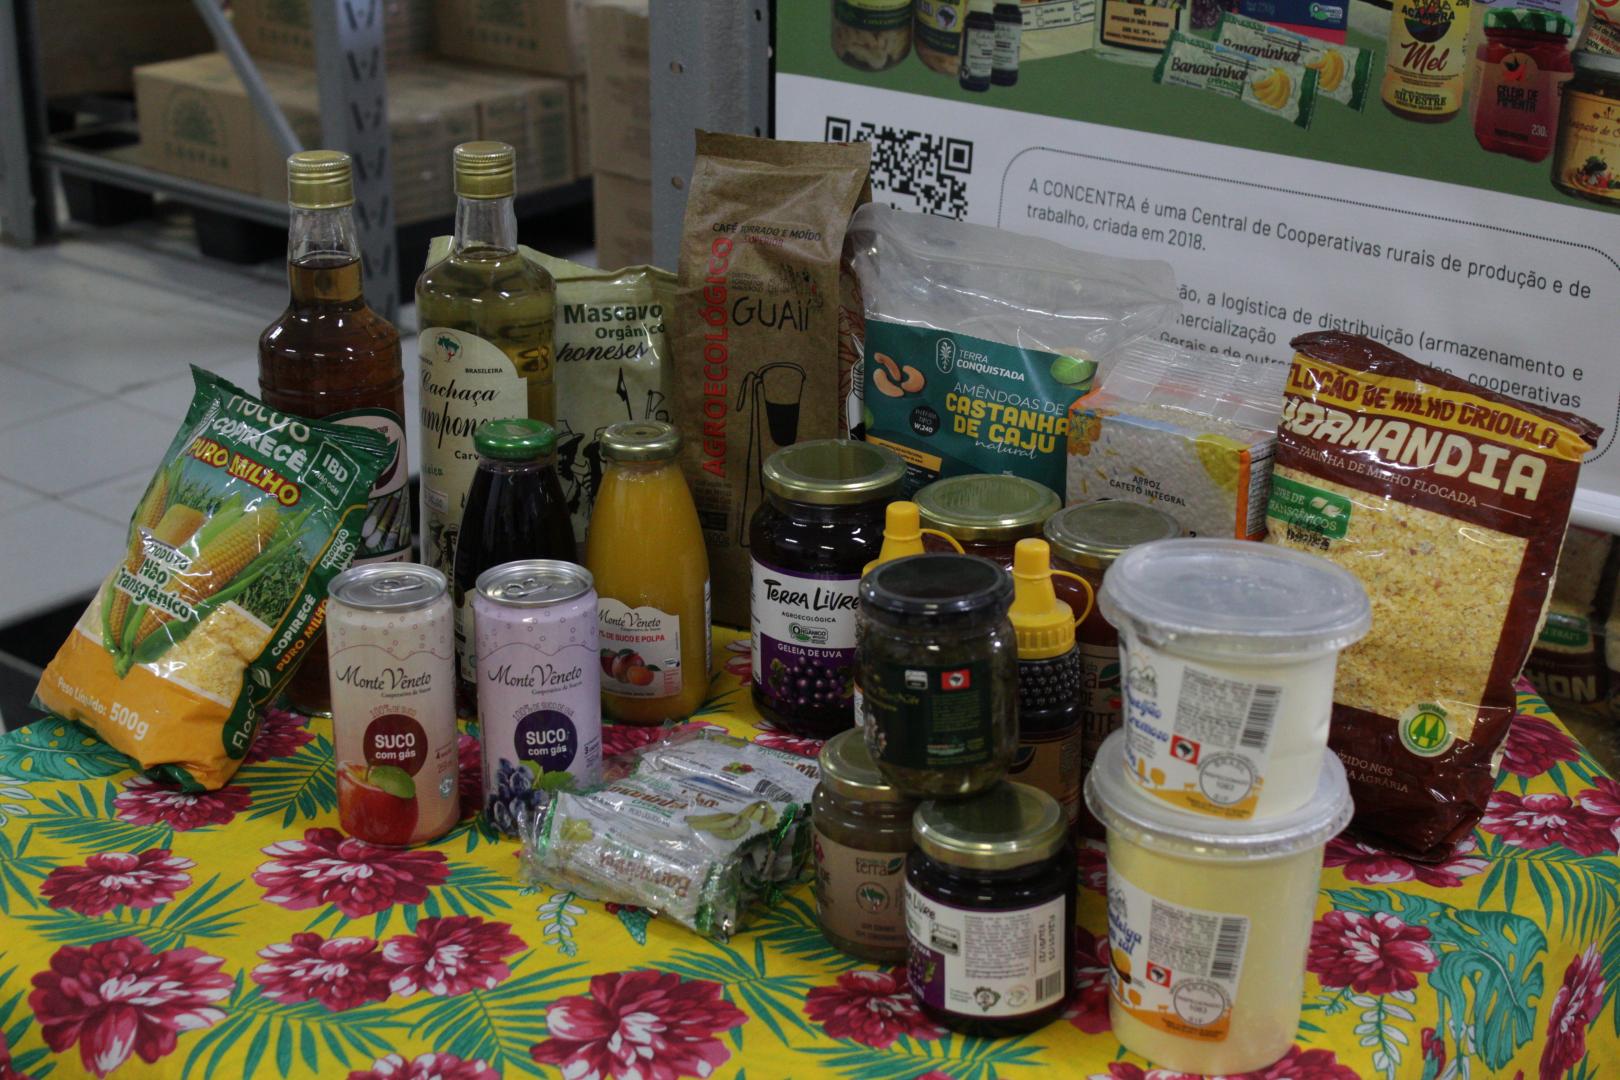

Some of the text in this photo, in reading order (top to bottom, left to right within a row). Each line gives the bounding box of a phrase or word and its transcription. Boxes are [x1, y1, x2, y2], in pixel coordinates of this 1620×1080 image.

[1171, 56, 1249, 81] Bananinha
[1401, 41, 1450, 74] Mel
[712, 221, 739, 234] CAFÉ
[789, 229, 822, 242] MOÍDO
[1026, 204, 1206, 252] trabalho, criada em 2018.
[1029, 178, 1591, 299] A CONCENTRA é uma Central de Cooperativas rurais de produção e de
[563, 302, 664, 325] Mascavo
[595, 322, 666, 342] Orgânico
[1207, 293, 1216, 306] a
[1221, 291, 1287, 321] logística
[1292, 307, 1312, 325] de
[1318, 312, 1414, 347] distribuição
[1419, 330, 1566, 380] (armazenamento
[1571, 369, 1584, 381] e
[464, 367, 504, 375] BRASILEIRA
[699, 237, 734, 478] AGROECOLÓGICO
[957, 359, 1025, 382] CONQUISTADA
[959, 349, 989, 365] TERRA
[421, 368, 500, 408] Cachaça
[952, 381, 1065, 416] AMÊNDOAS DE
[1468, 371, 1581, 409] cooperativas
[944, 391, 1071, 437] CASTANHA
[1287, 362, 1559, 450] LOCÃO DE MILHO CRIOULO
[211, 415, 309, 475] COPIRECÊ
[953, 414, 1057, 455] DE CAJU
[975, 438, 1038, 460] natural
[187, 435, 302, 508] PURO MILHO
[320, 452, 350, 484] IBD
[1297, 444, 1479, 509] FARINHA DE MILHO FLOCADA
[1109, 479, 1187, 507] CATETO INTEGRAL
[1132, 475, 1161, 490] ARROZ
[1290, 492, 1306, 506] DE
[320, 528, 350, 569] PRODUTO
[332, 543, 355, 571] Não
[138, 557, 168, 585] Não
[271, 593, 317, 658] COPIRECÊ
[598, 608, 661, 629] Monte Vêneto
[781, 611, 837, 624] AGROECOLÓGICA
[276, 639, 306, 673] PURO
[777, 643, 843, 658] GELEIA DE UVA
[335, 664, 432, 691] Monte Vêneto
[487, 663, 582, 689] Monte Vêneto
[109, 702, 151, 741] 500g
[374, 732, 416, 750] SUCO
[525, 728, 567, 746] SUCO
[527, 743, 567, 757] com gás
[375, 748, 417, 761] com gás
[1368, 763, 1393, 778] NOS
[855, 858, 889, 876] terra
